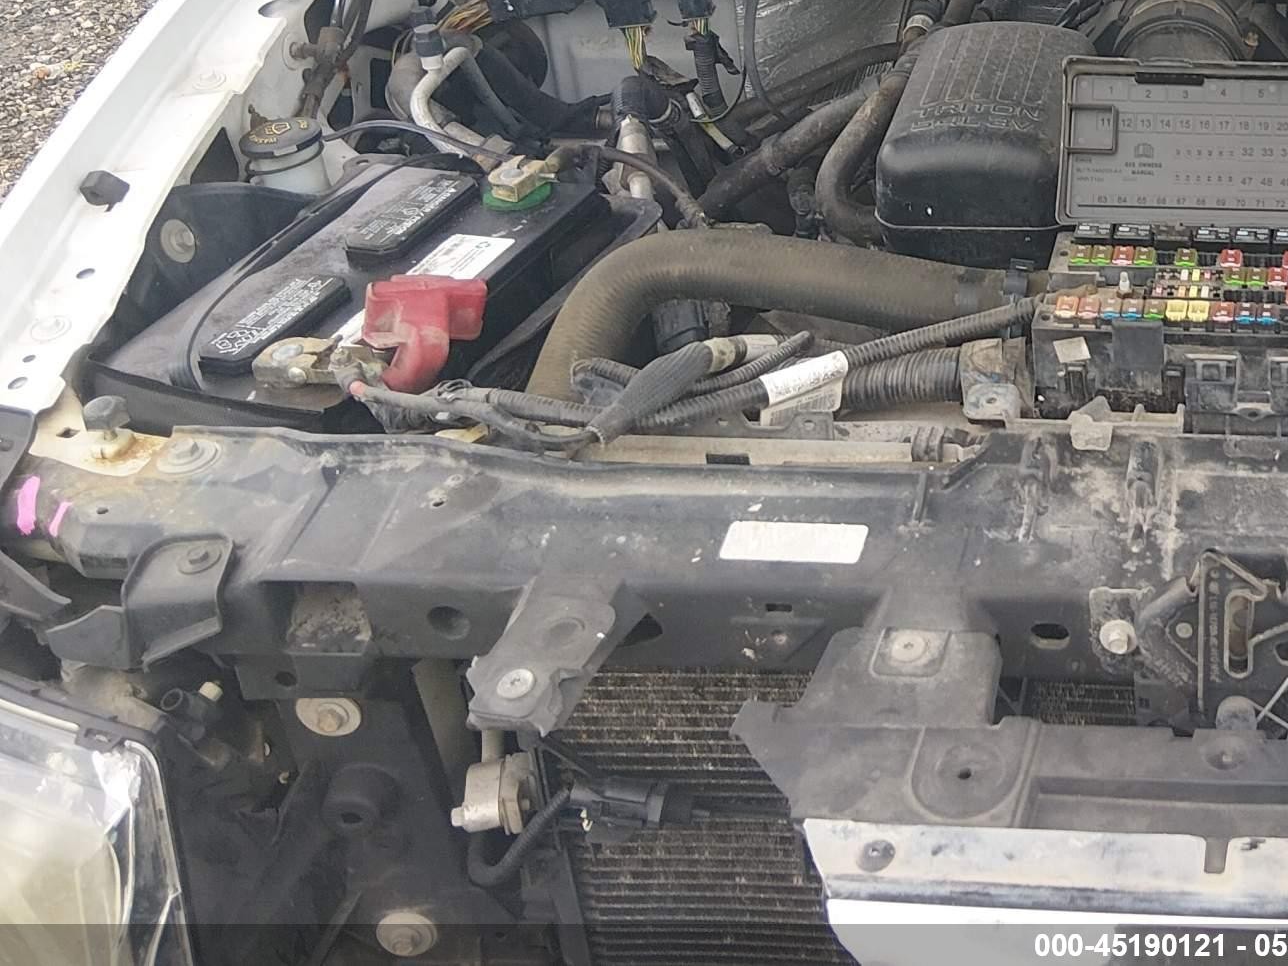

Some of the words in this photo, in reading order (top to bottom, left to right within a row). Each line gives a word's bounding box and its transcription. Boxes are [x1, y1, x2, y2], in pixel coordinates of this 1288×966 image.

[1101, 118, 1112, 127] 11
[1121, 119, 1132, 127] 12
[1140, 119, 1151, 128] 13
[1160, 119, 1170, 128] 14
[1180, 120, 1190, 128] 15
[1200, 121, 1210, 129] 16
[1219, 121, 1229, 129] 17
[1259, 122, 1269, 130] 19
[1277, 122, 1288, 131] 20
[1242, 148, 1254, 156] 32
[1262, 148, 1274, 156] 33
[1240, 178, 1252, 186] 47
